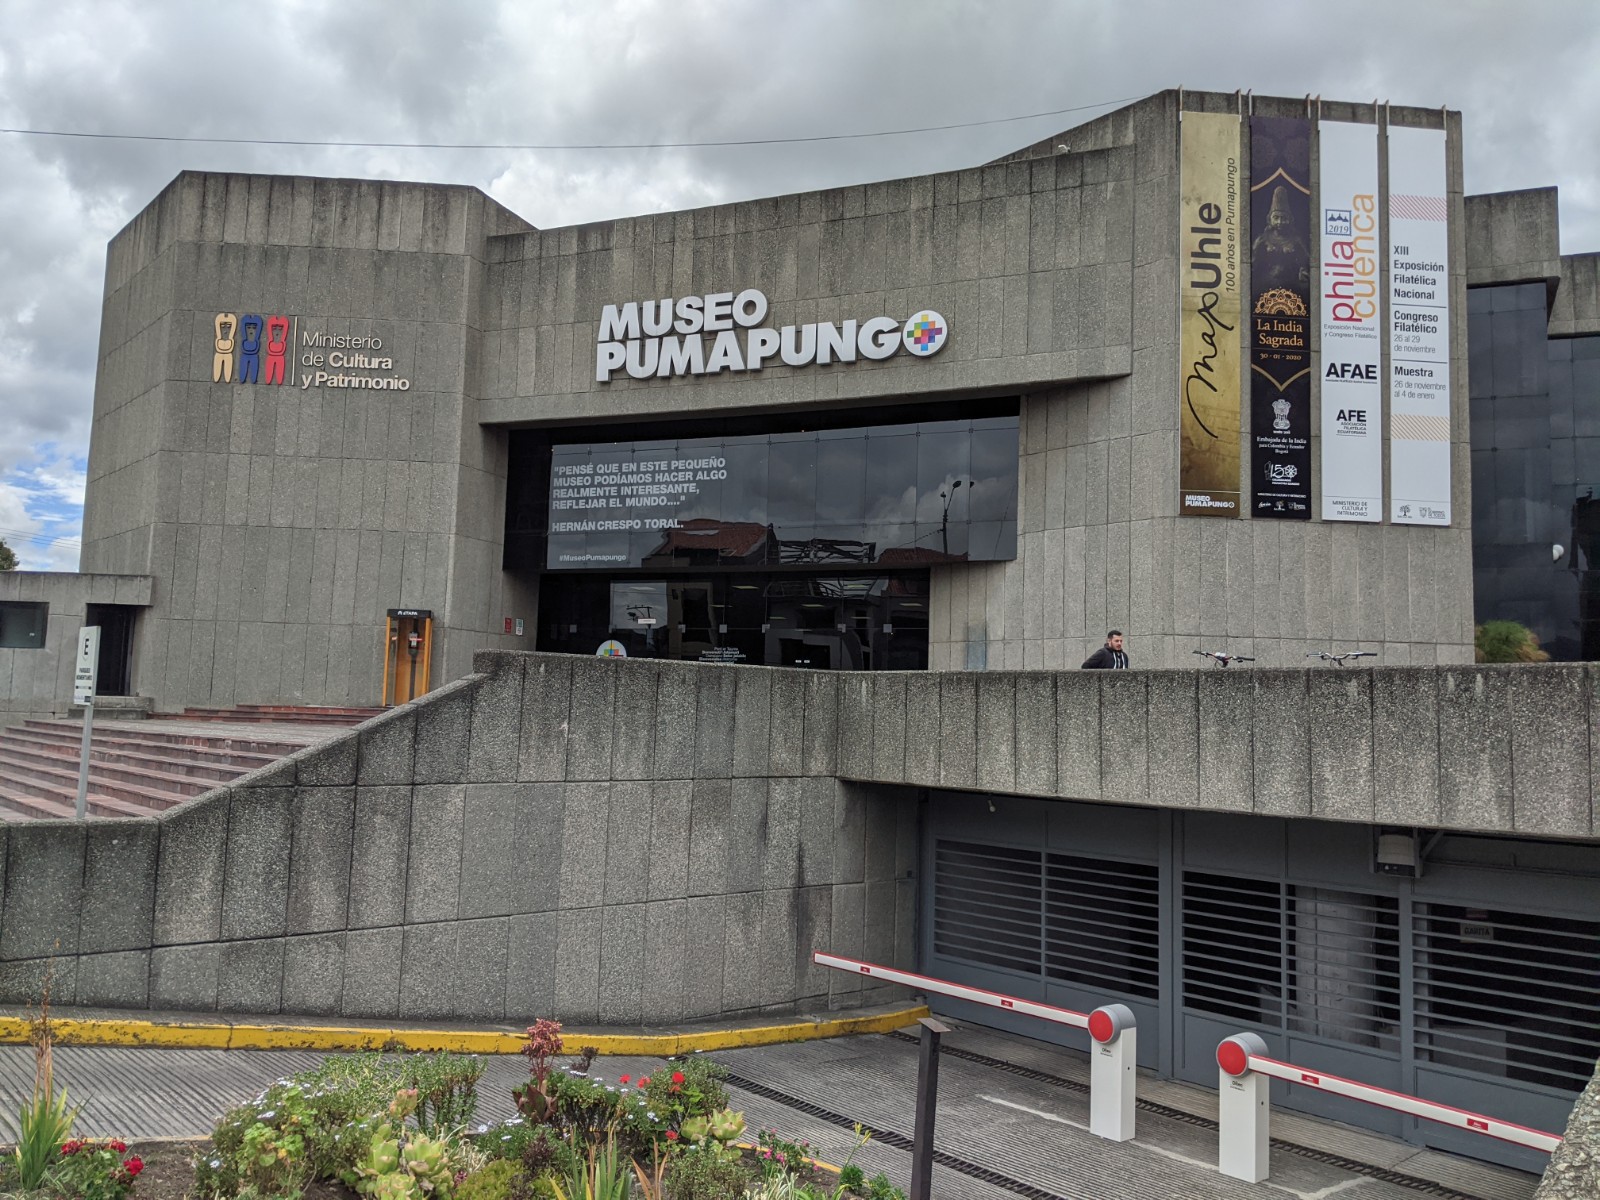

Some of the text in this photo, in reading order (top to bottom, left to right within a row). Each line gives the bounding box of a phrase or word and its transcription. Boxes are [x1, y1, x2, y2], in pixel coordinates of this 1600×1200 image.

[1226, 157, 1238, 293] 100 años en Pumapungo
[1328, 224, 1349, 234] 2019
[1191, 203, 1222, 288] Uhle
[1394, 245, 1409, 256] XIII
[1352, 194, 1376, 319] cuenca
[1394, 260, 1444, 272] Exposición
[1324, 240, 1362, 322] phila
[1394, 274, 1436, 286] Filatélica
[1394, 288, 1434, 300] Nacional
[598, 288, 768, 342] MUSEO
[1394, 310, 1438, 323] Congreso
[1256, 318, 1303, 333] La India
[1394, 322, 1437, 334] Filatélico
[302, 331, 382, 350] Ministerio
[1258, 332, 1304, 348] Sagrada
[1394, 334, 1403, 342] 26
[596, 309, 948, 383] PUMAPUNGO
[1404, 345, 1436, 353] noviembre
[302, 351, 393, 370] de Cultura
[1326, 362, 1377, 380] AFAE
[1394, 366, 1433, 377] Muestra
[302, 371, 410, 391] y Patrimonio
[1394, 380, 1403, 388] 26
[1414, 382, 1446, 390] noviembre
[1336, 409, 1366, 422] AFE
[596, 464, 619, 474] QUE
[622, 463, 636, 472] EN
[640, 461, 668, 472] ESTE
[671, 456, 726, 470] PEQUEÑO
[554, 470, 727, 487] MUSEO PODÍAMOS HACER ALGO
[553, 483, 700, 498] REALMENTE INTERESANTE,
[552, 499, 606, 510] REFLEJAR
[609, 498, 623, 508] EL
[552, 518, 684, 532] HERNÁN CRESPO TORAL.
[559, 554, 627, 562] #MuseoPumapungo
[84, 639, 89, 655] E
